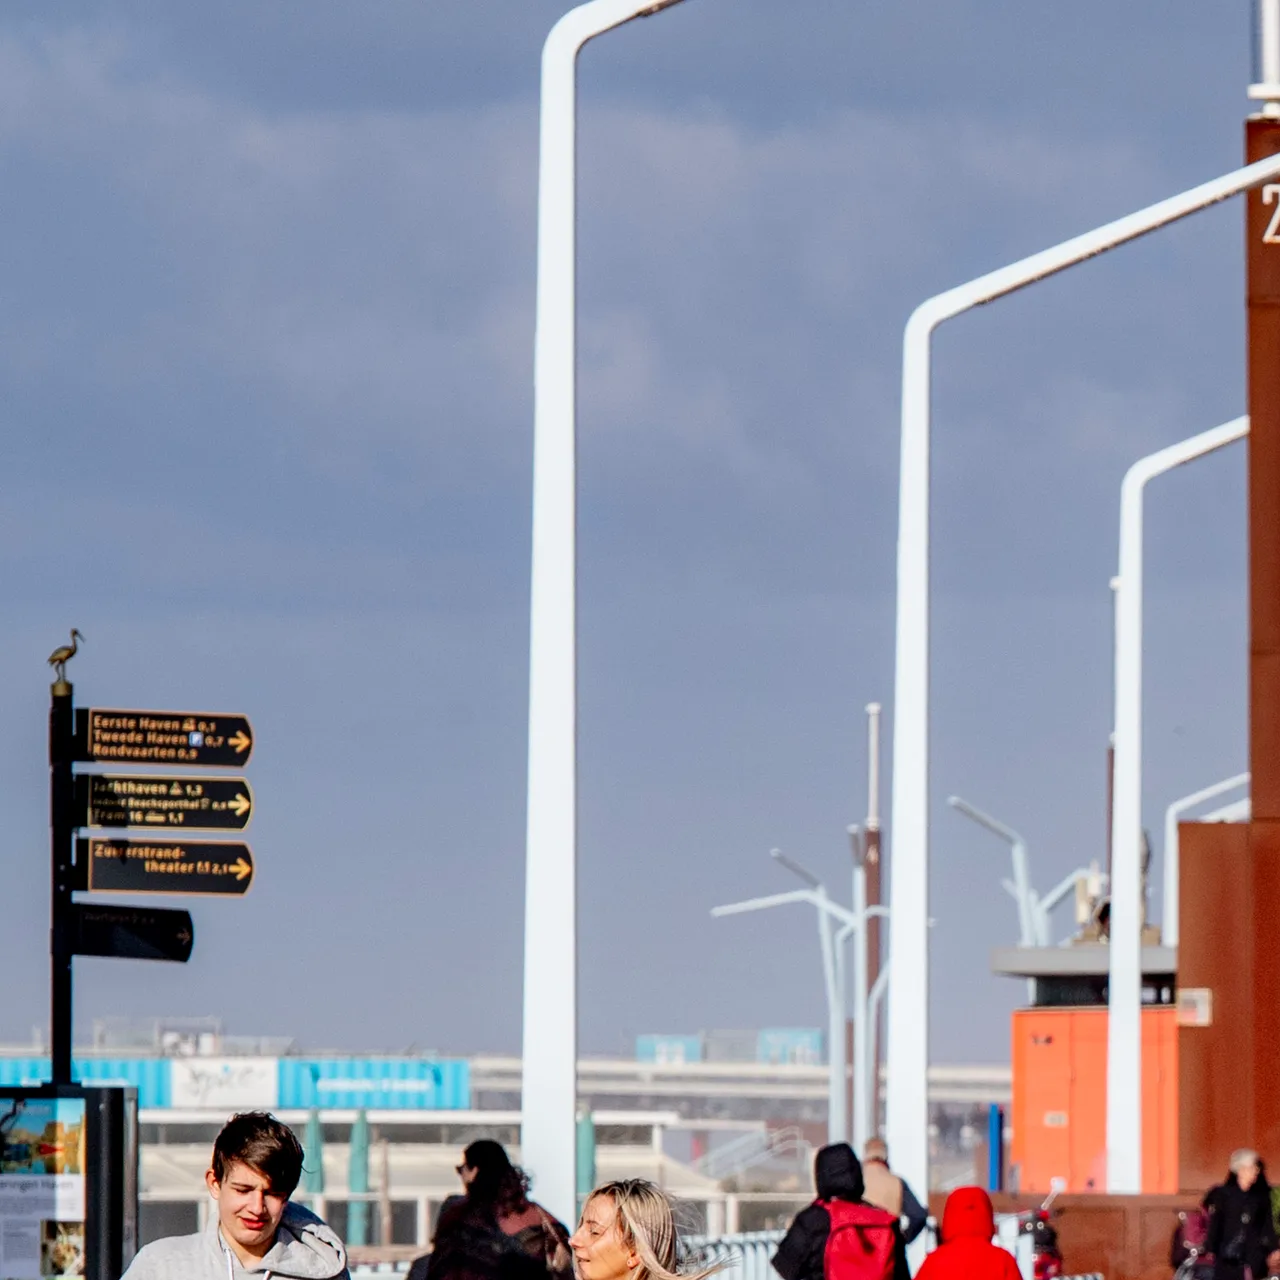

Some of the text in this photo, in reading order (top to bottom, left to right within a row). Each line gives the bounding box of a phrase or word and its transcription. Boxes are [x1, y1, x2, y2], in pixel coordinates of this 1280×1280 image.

[94, 715, 137, 729] Eerste
[139, 717, 180, 731] Haven
[94, 729, 144, 743] Tweede
[146, 731, 188, 746] Haven
[92, 743, 177, 759] Rondvaarten
[144, 860, 194, 874] theater
